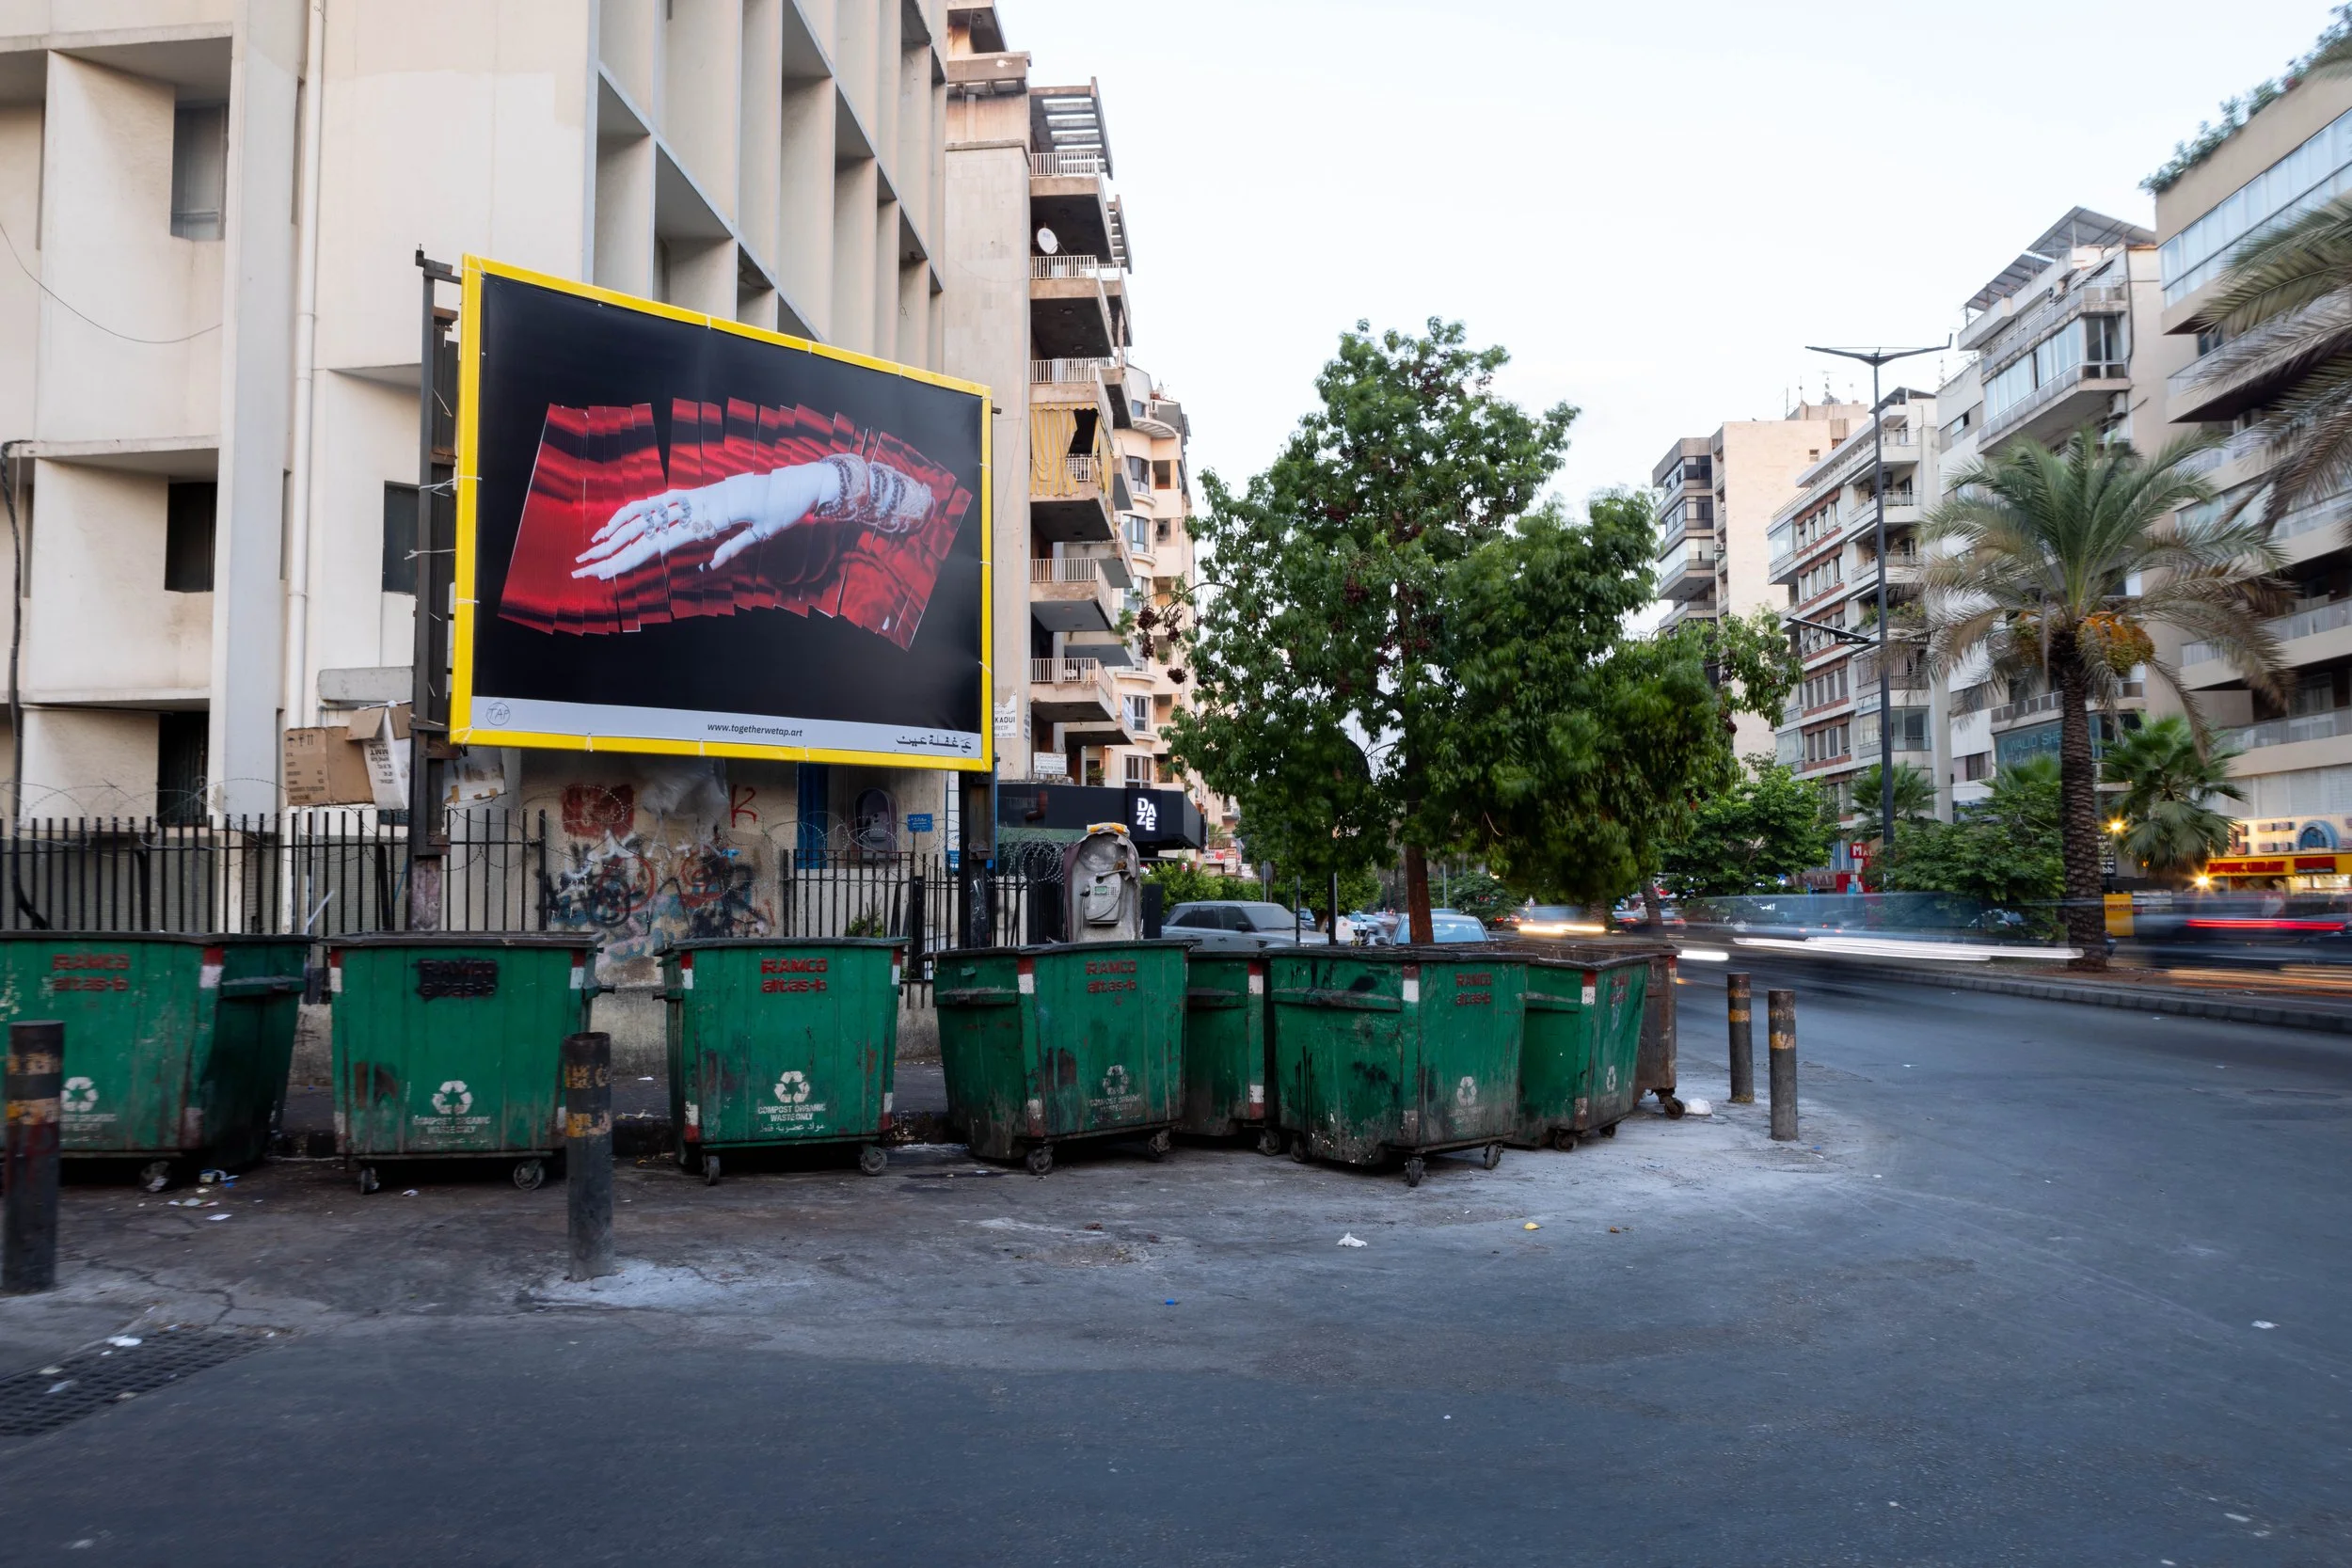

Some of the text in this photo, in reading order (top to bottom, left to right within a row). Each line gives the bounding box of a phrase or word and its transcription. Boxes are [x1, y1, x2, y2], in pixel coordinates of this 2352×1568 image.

[707, 723, 803, 736] www.togetherwetap.art
[2042, 730, 2061, 745] SHE
[760, 958, 828, 974] RAMCO
[1086, 960, 1136, 974] RAMCO
[758, 1103, 826, 1115] COMPOST ORGANIC
